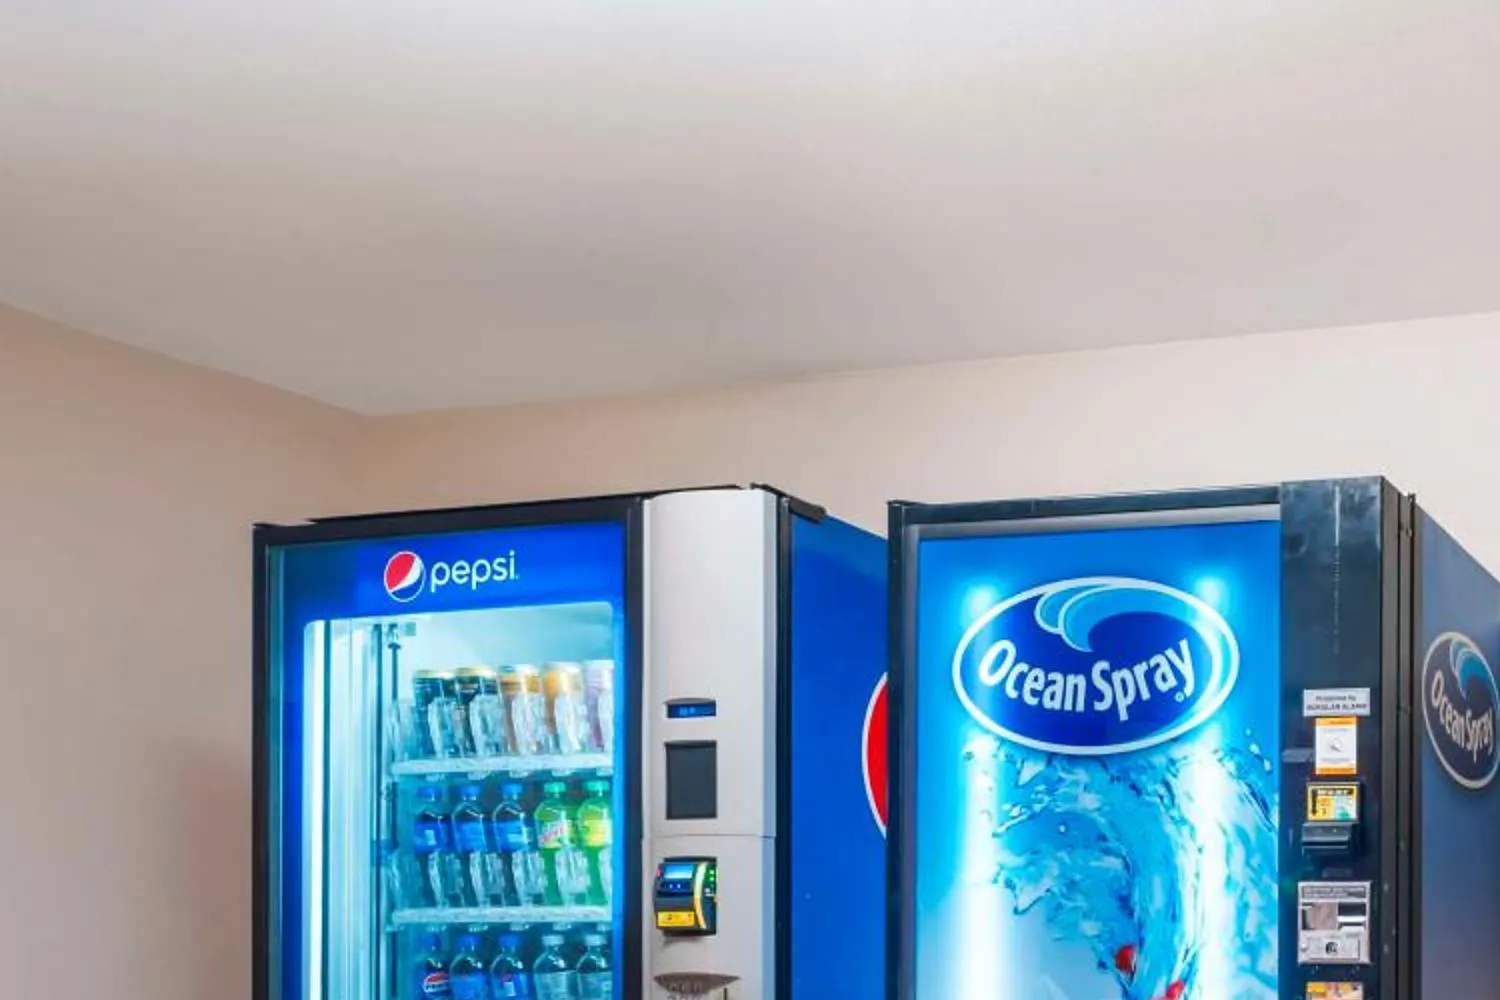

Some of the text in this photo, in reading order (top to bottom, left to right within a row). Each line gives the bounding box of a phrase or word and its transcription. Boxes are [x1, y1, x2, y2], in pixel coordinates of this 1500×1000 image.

[430, 549, 516, 593] pepsi
[978, 637, 1196, 722] Ocean Spray
[1431, 669, 1494, 764] Ocean Spray
